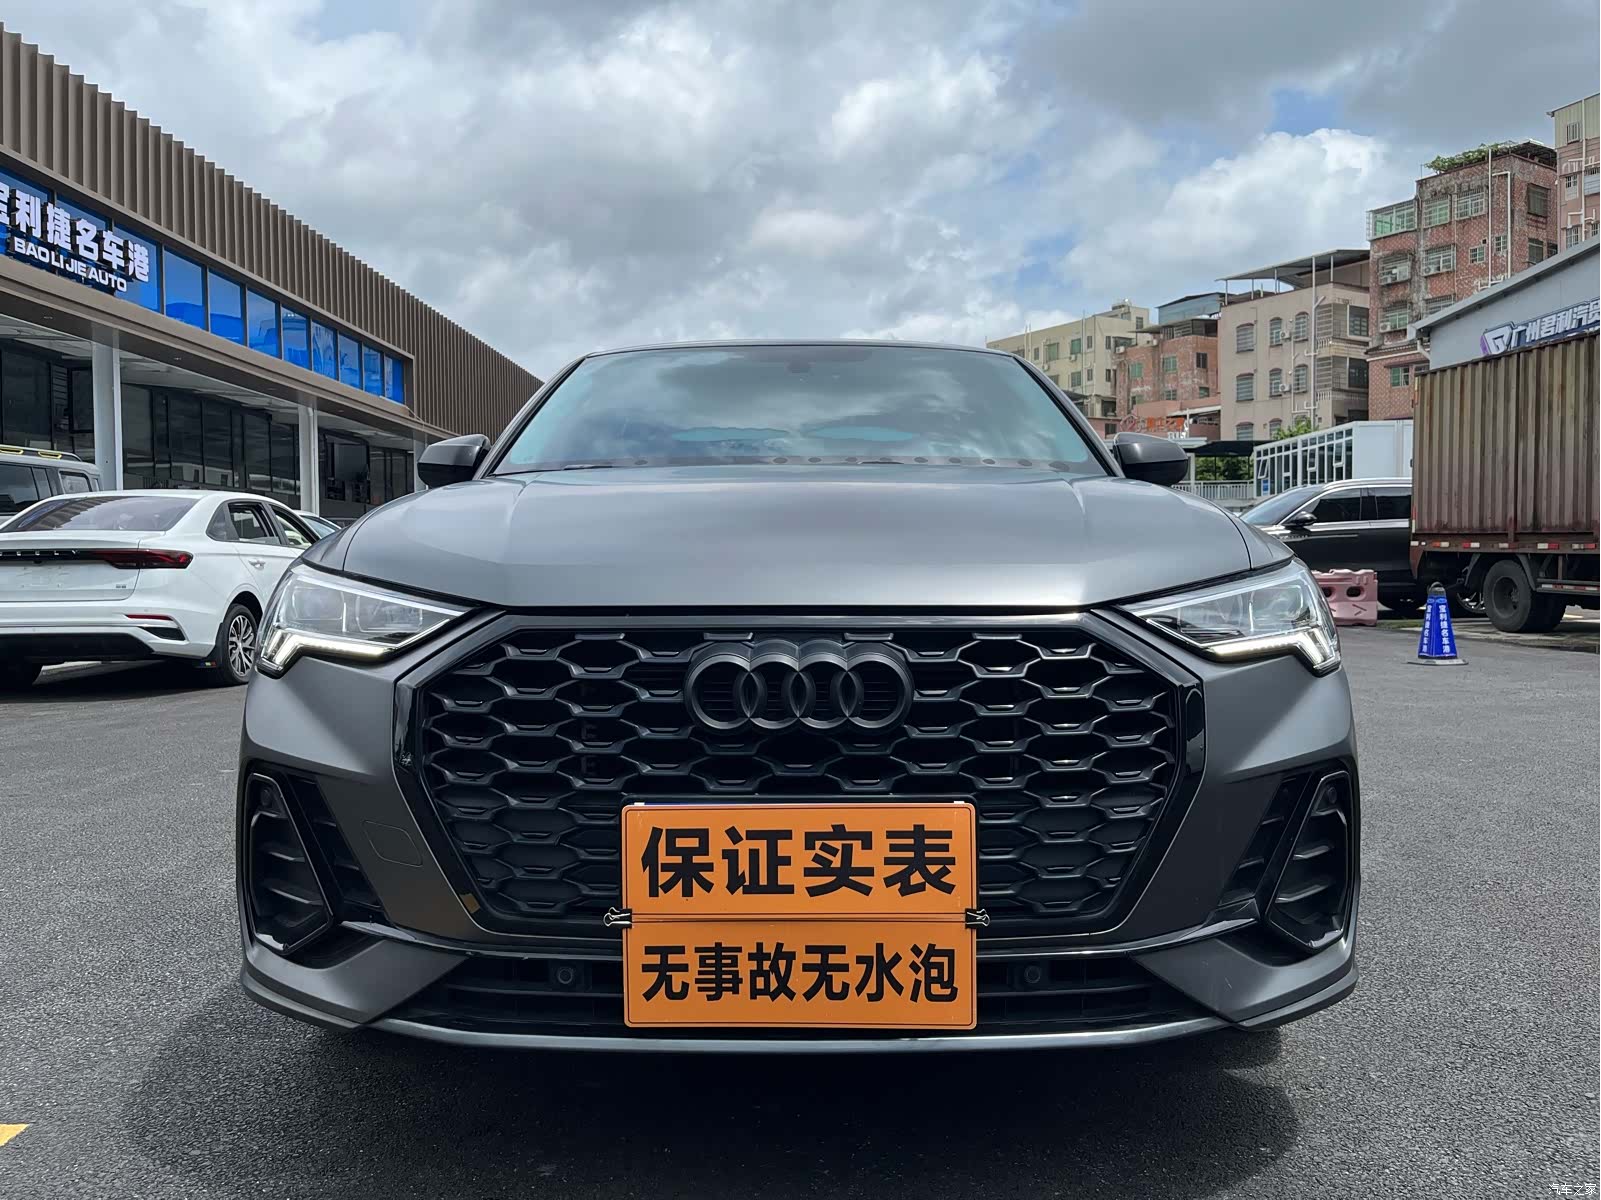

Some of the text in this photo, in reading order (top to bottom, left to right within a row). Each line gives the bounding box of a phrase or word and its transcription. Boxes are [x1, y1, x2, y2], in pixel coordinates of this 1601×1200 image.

[641, 824, 957, 898] 保证实表
[641, 942, 958, 1003] 无事故无水泡
